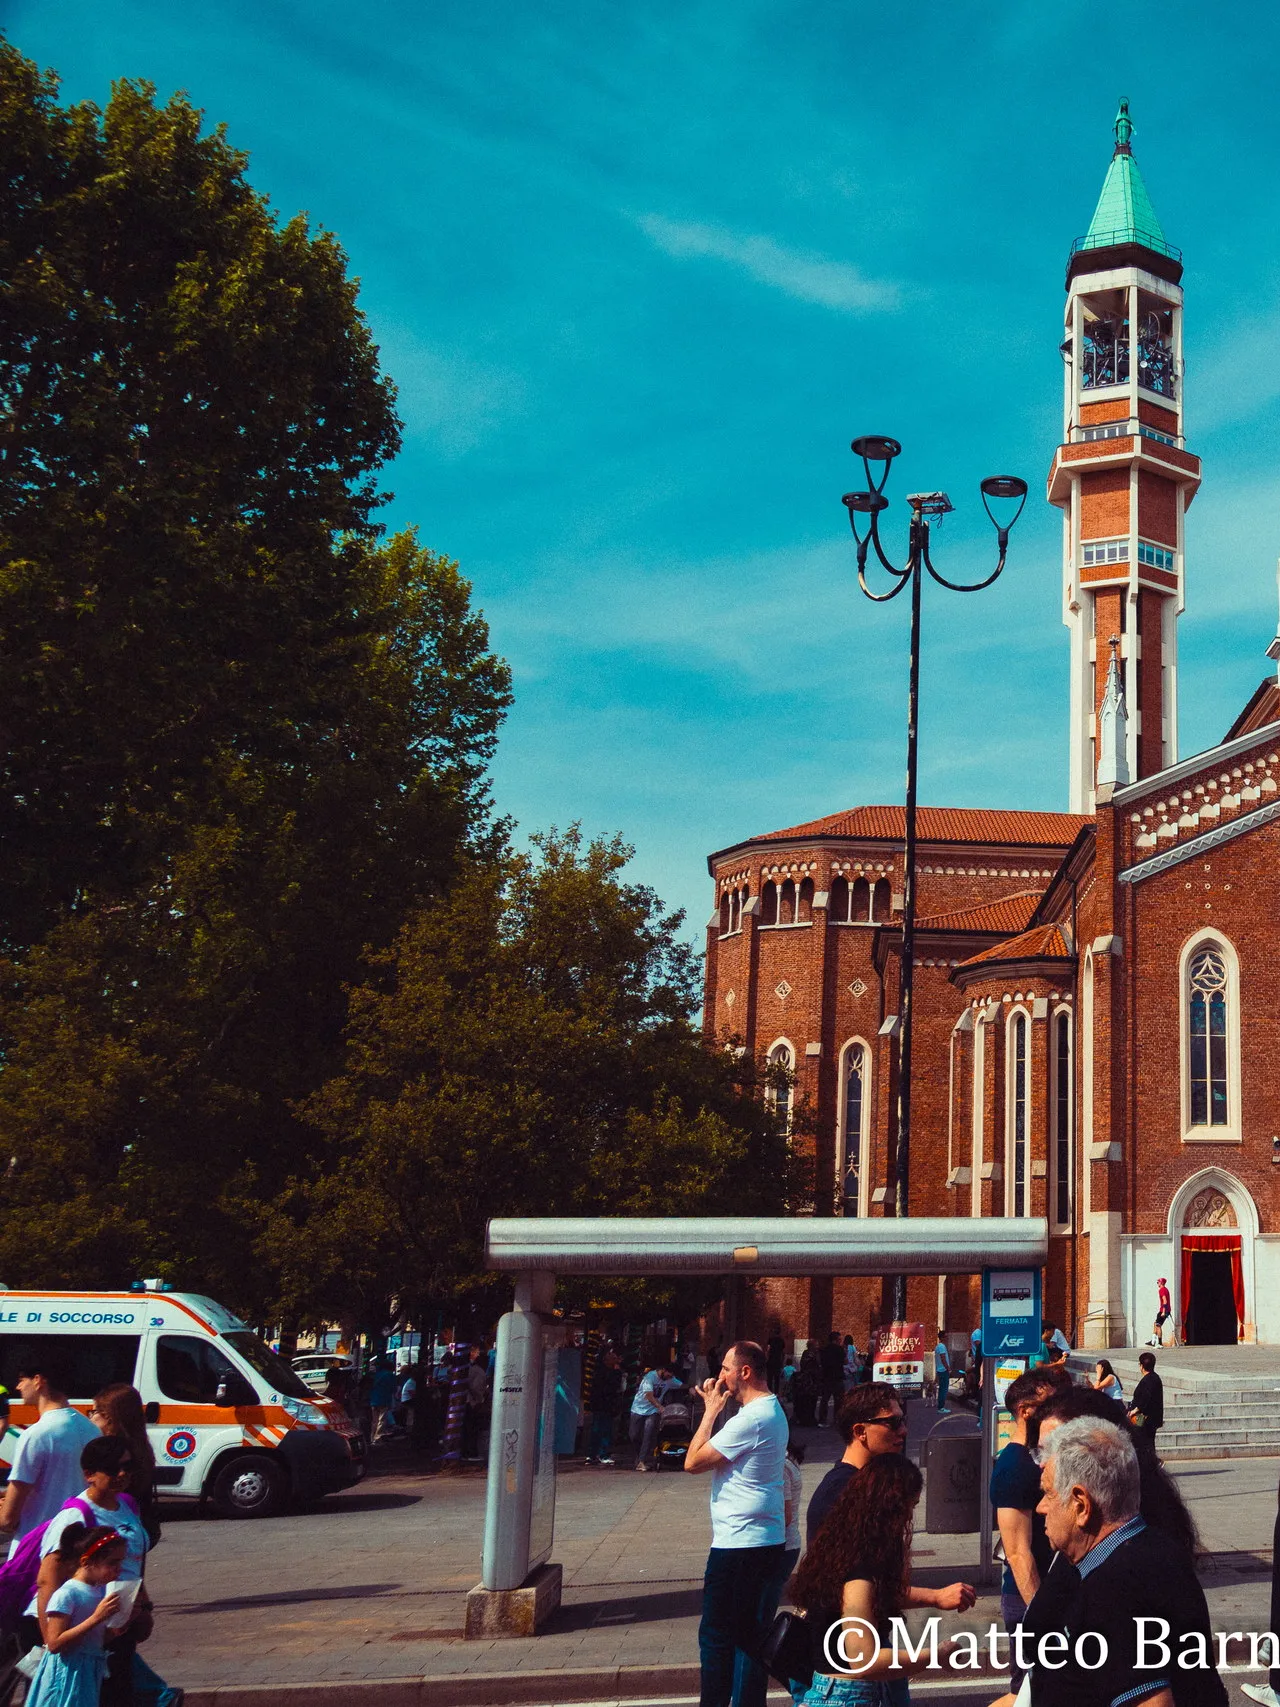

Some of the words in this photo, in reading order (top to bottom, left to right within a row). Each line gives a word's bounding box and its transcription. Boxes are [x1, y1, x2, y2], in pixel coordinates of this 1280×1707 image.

[27, 1313, 41, 1323] DI
[49, 1312, 135, 1324] SOCCORSO
[880, 1332, 898, 1340] GIN,
[880, 1338, 921, 1346] WHISKEY,
[999, 1334, 1025, 1348] ASF
[879, 1345, 915, 1353] VODKA?
[269, 1394, 279, 1403] 4
[162, 1452, 197, 1466] SOCCORSO
